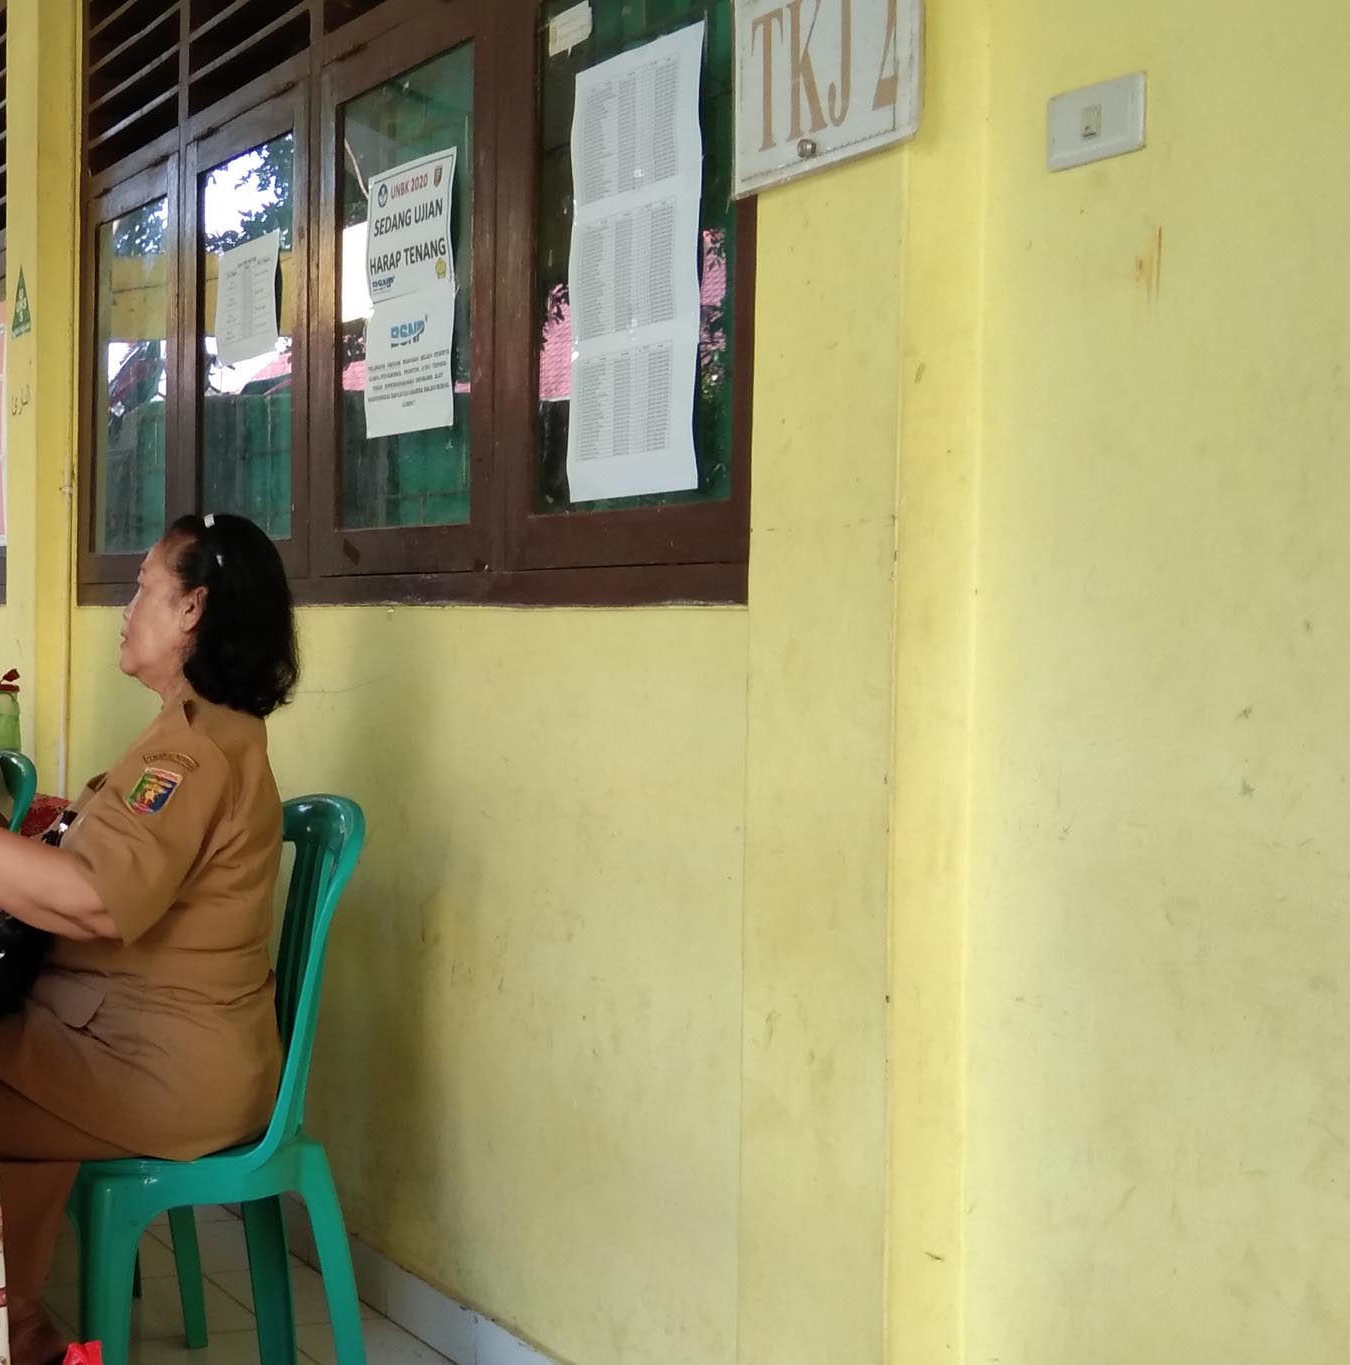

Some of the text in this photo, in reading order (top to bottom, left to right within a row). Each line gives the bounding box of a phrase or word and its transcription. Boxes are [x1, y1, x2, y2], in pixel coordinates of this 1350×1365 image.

[751, 0, 851, 153] TKJ
[390, 173, 428, 200] UNBK 2020
[374, 198, 443, 237] SEDANG UJIAN
[370, 237, 446, 275] HARAP TENANG
